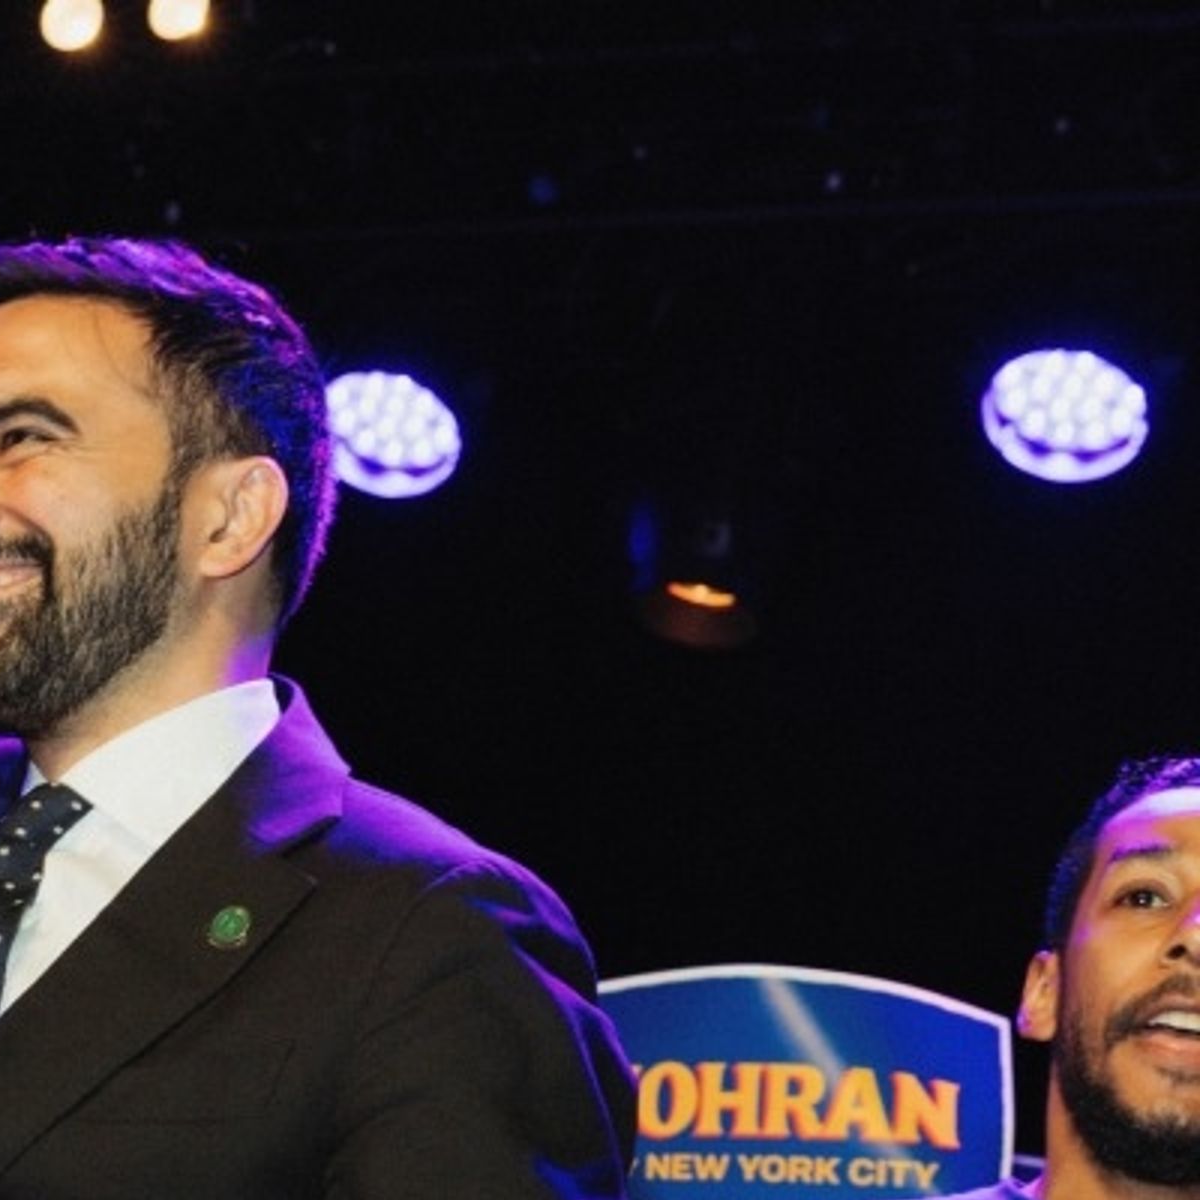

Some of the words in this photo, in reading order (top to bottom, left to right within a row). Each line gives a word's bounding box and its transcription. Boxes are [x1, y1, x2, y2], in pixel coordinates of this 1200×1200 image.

[632, 1061, 961, 1149] OHRAN
[645, 1153, 729, 1181] NEW
[737, 1153, 840, 1184] YORK
[847, 1157, 940, 1190] CITY
